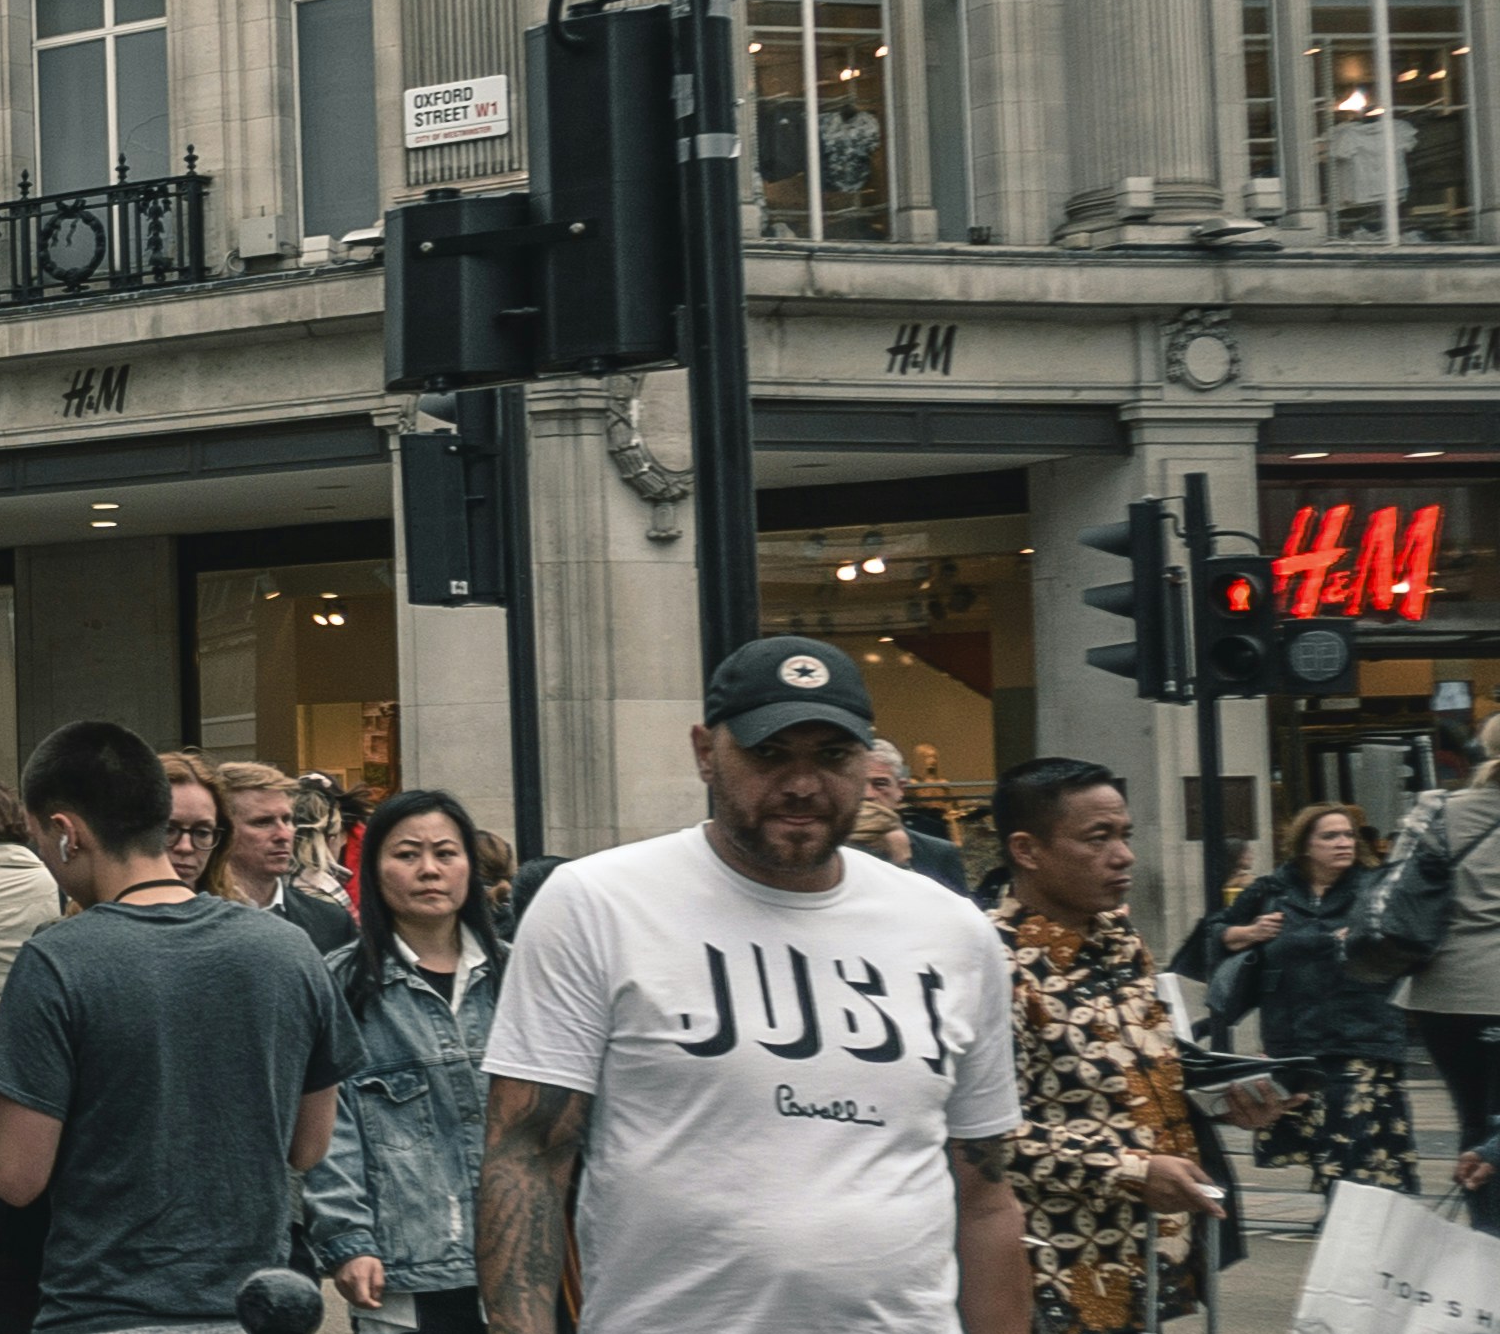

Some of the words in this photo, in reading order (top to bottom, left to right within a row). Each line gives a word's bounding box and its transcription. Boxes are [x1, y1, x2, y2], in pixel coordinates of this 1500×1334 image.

[414, 87, 473, 109] OXFORD
[414, 105, 470, 127] STREET
[475, 101, 498, 117] W1
[886, 323, 958, 376] H&M
[62, 364, 131, 418] H&M
[1272, 502, 1443, 622] H&M
[671, 930, 951, 1078] JUST
